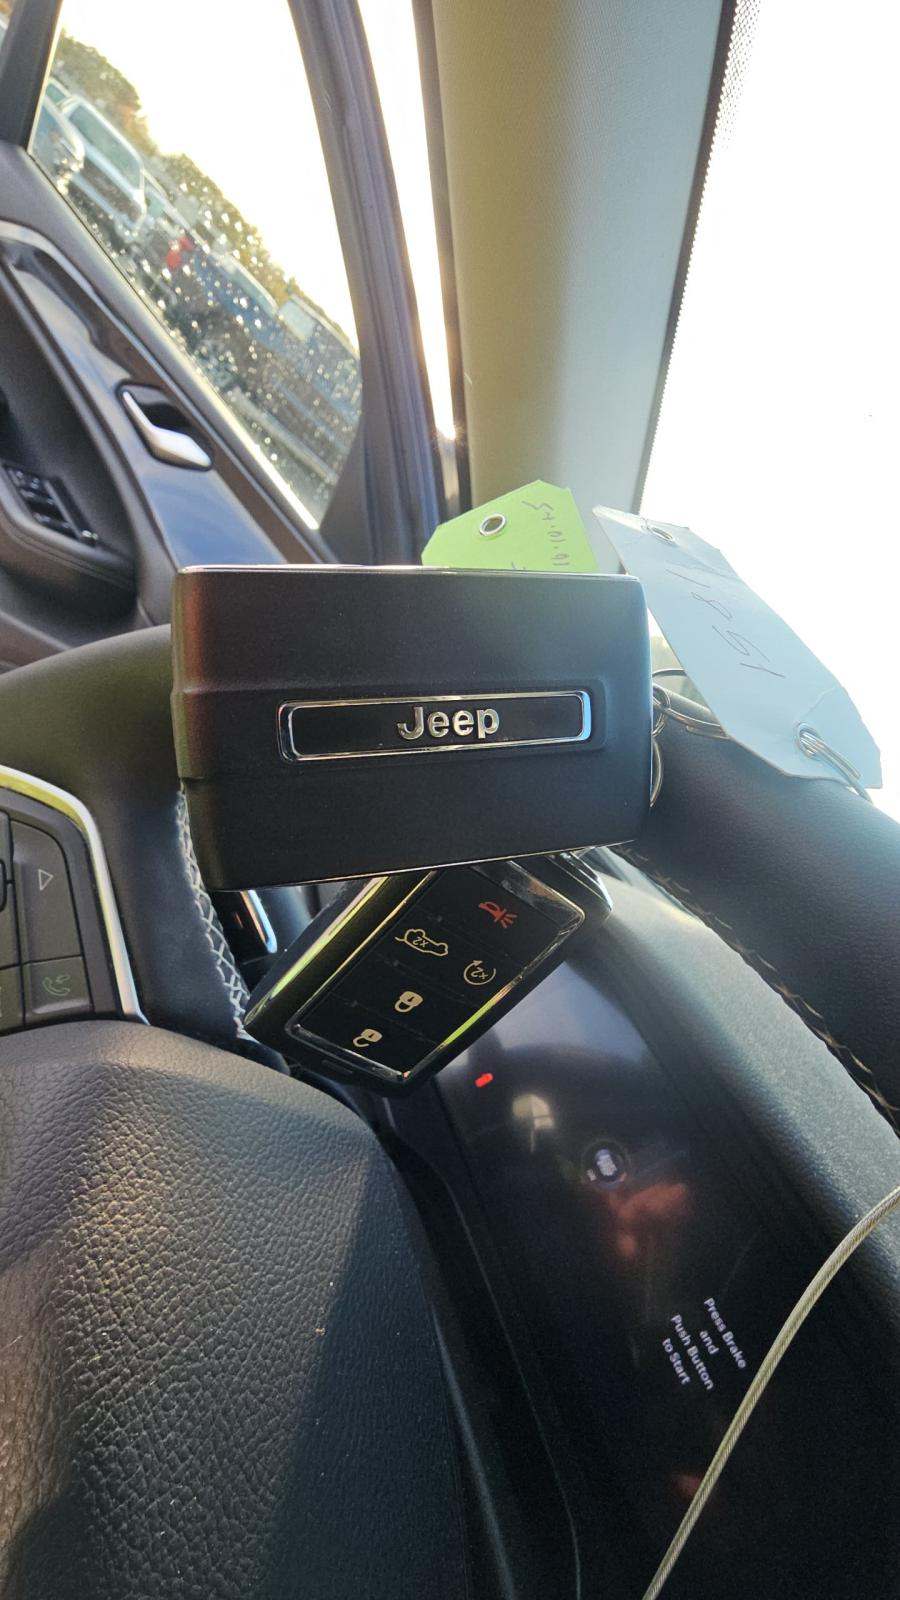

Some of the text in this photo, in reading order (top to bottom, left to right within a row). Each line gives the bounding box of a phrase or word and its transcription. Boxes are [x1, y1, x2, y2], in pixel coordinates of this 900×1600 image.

[396, 706, 500, 740] Jeep
[670, 1314, 714, 1390] Push Button
[699, 1330, 719, 1355] and
[704, 1297, 746, 1369] Press Brake
[662, 1337, 691, 1385] to Start
